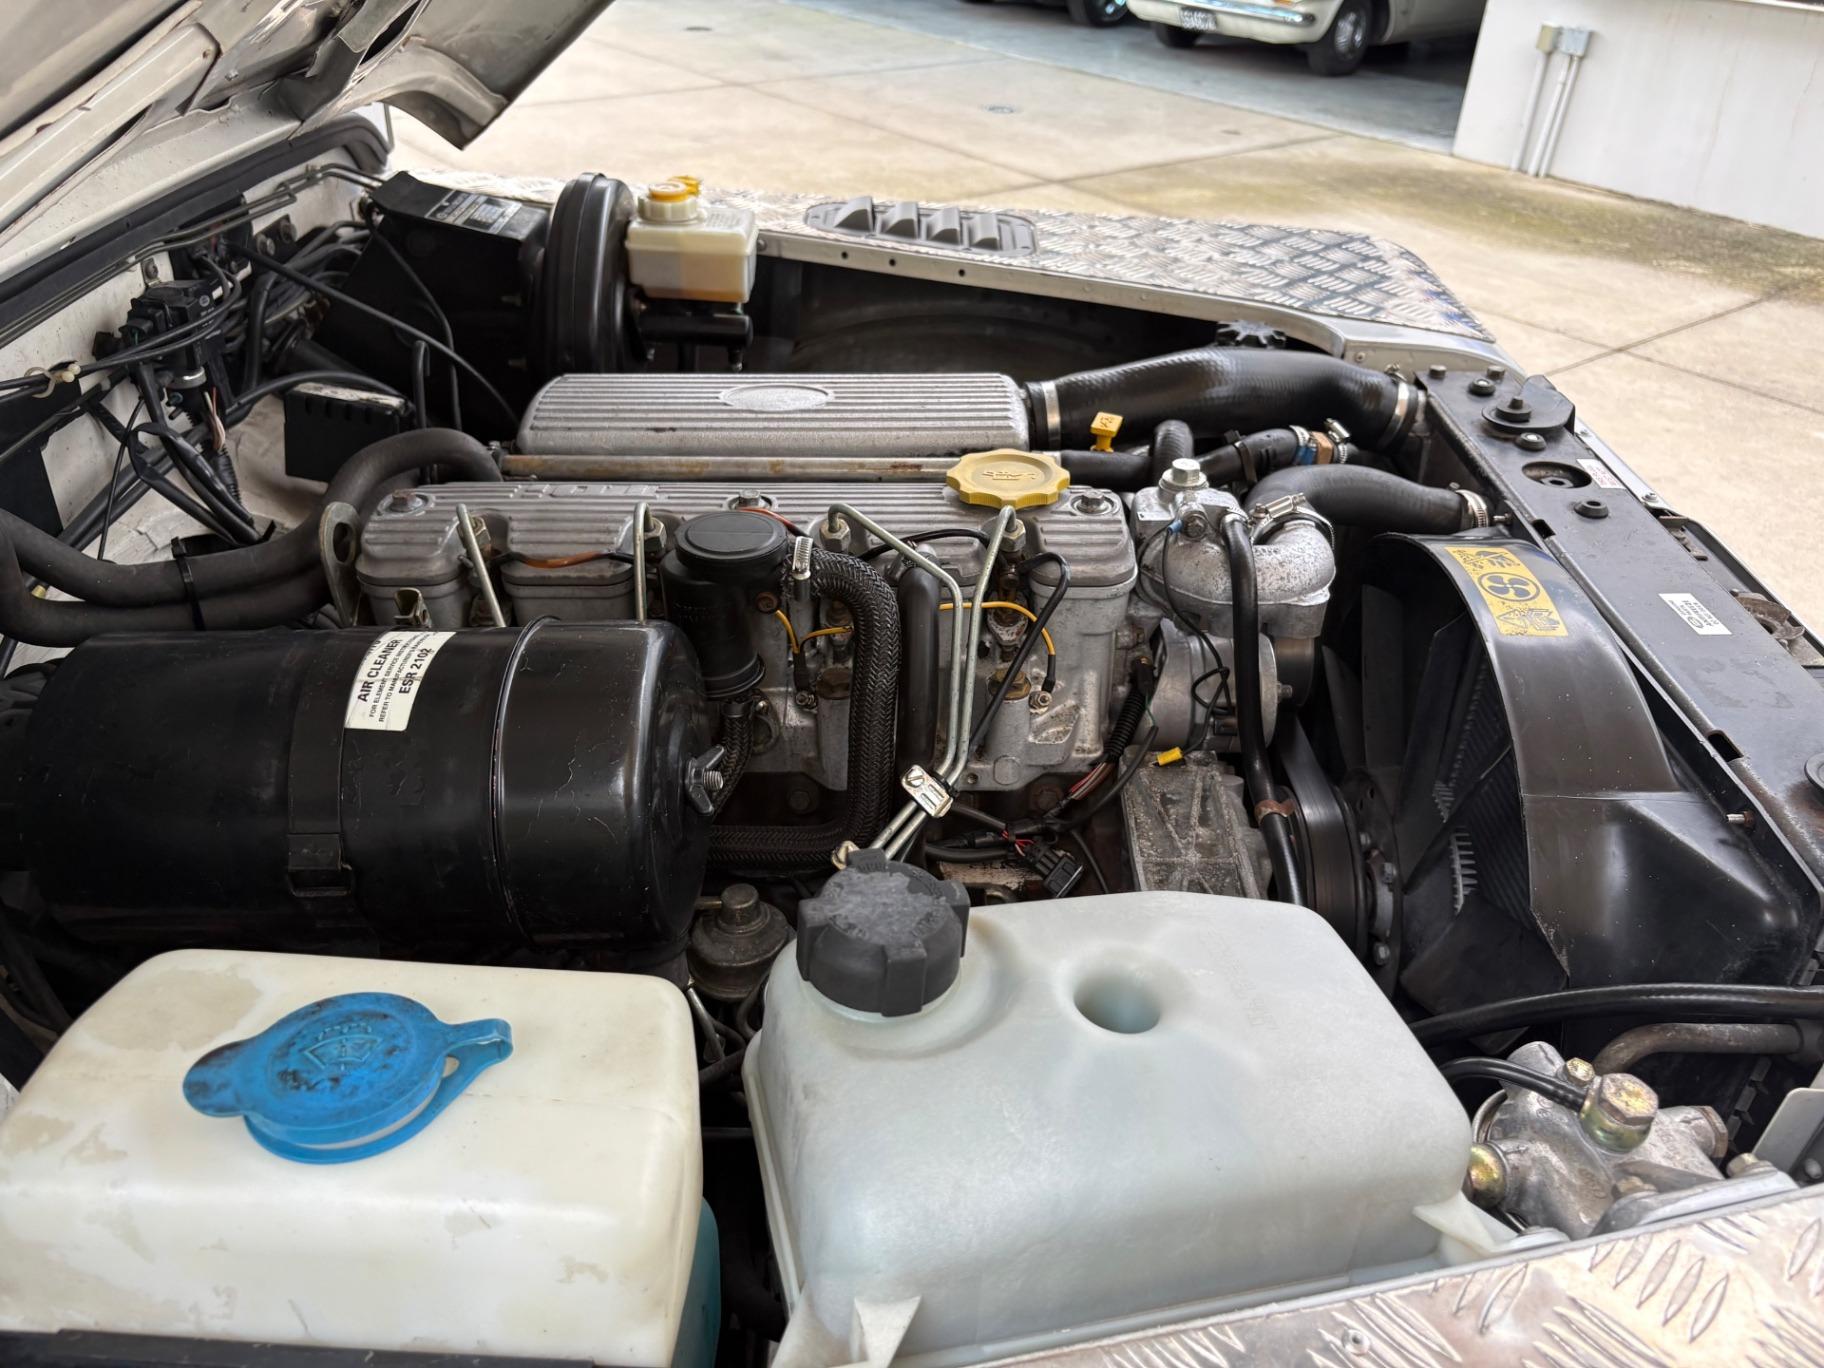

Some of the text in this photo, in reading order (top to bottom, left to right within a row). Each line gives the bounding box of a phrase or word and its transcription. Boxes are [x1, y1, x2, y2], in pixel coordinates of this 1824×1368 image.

[358, 681, 374, 702] AIR
[367, 639, 402, 678] CLEANER
[399, 672, 417, 694] ESR
[410, 648, 432, 670] 2102
[369, 704, 377, 718] FOR
[378, 701, 389, 722] REFER
